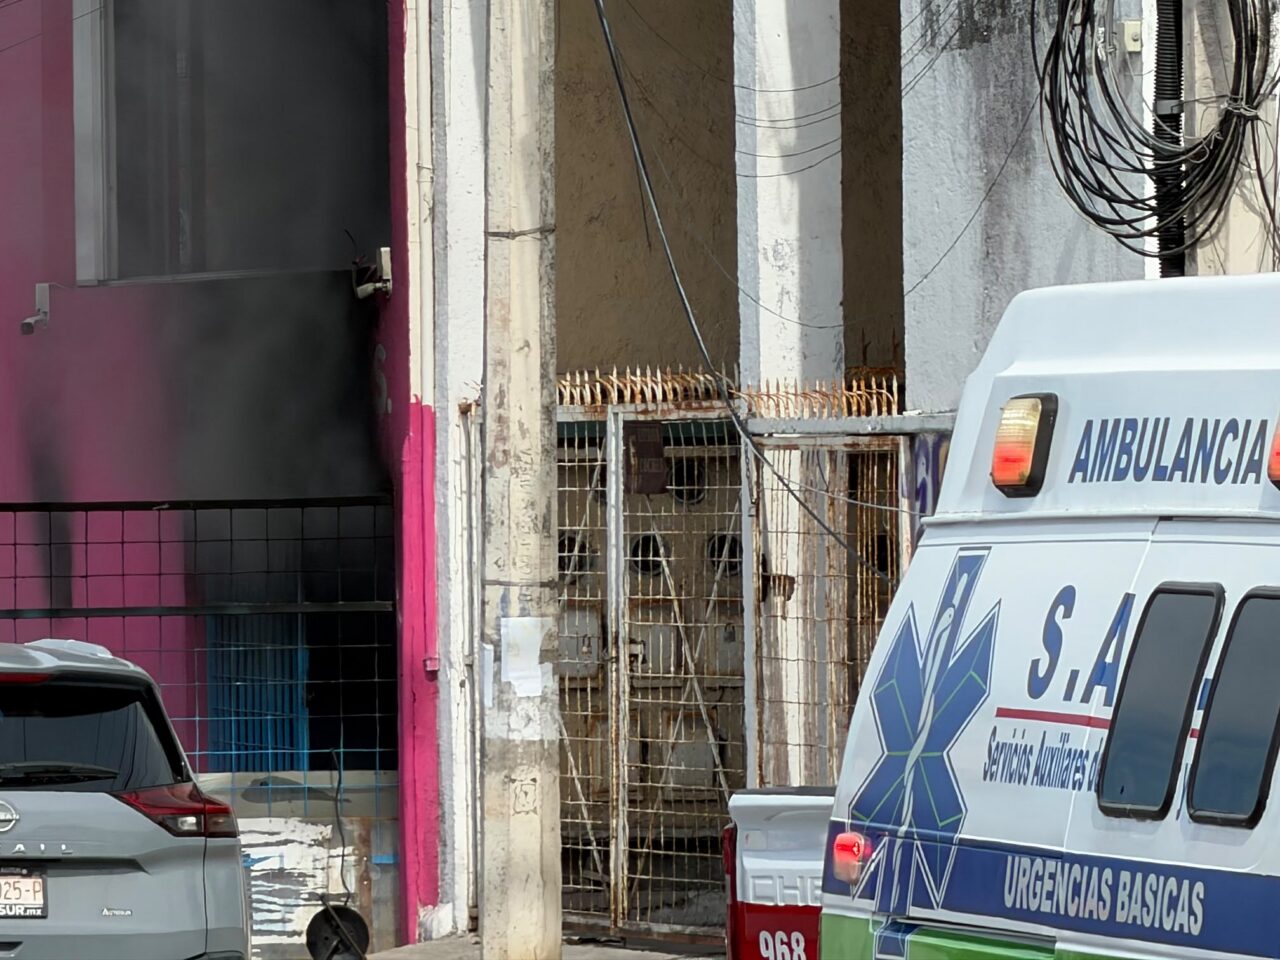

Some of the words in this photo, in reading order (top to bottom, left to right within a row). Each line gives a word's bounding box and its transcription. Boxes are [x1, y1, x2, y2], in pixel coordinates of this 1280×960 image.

[1067, 417, 1269, 485] AMBULANCIA
[982, 725, 1034, 785] Servicios
[1030, 730, 1089, 792] Auxiliares
[1002, 855, 1111, 921] URGENCIAS
[1115, 868, 1206, 937] BASICAS
[759, 930, 808, 960] 968
